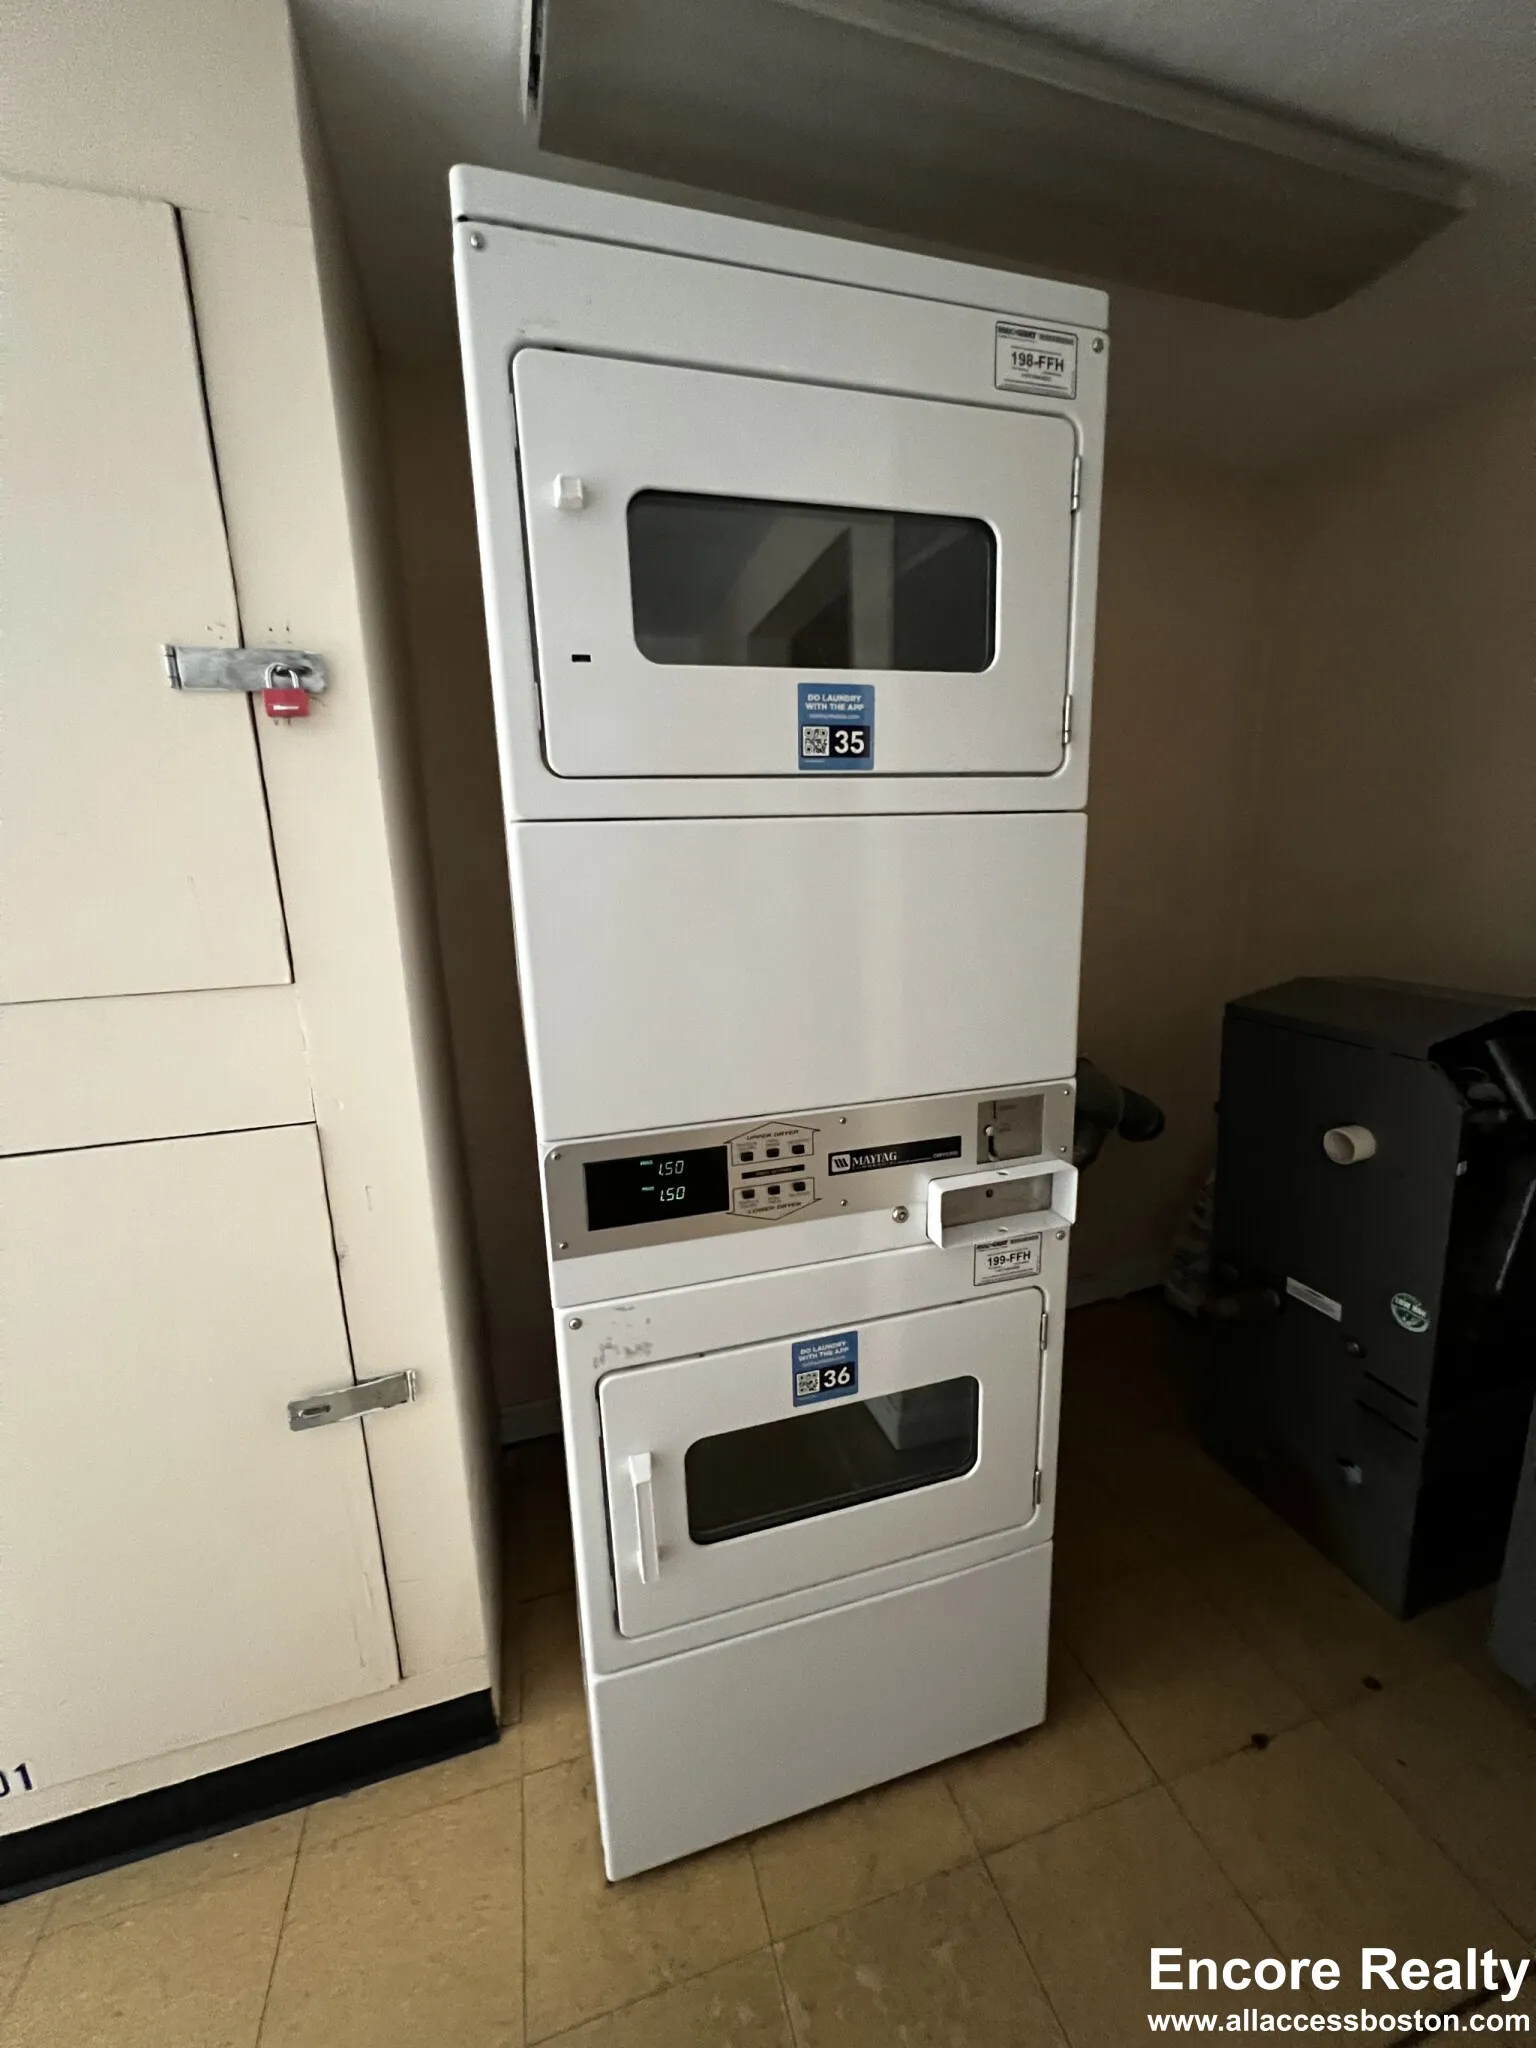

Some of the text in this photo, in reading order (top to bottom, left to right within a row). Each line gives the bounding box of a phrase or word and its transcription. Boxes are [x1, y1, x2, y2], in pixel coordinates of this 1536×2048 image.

[1011, 351, 1064, 372] 198-FFH
[805, 702, 864, 711] WITH THE APP
[807, 694, 861, 703] DO LAUNDRY
[834, 730, 865, 754] 35
[851, 1151, 897, 1166] MAYTAG
[658, 1160, 684, 1176] 1.50
[660, 1186, 686, 1202] 1.50
[987, 1250, 1031, 1266] 199-FFH
[823, 1366, 851, 1388] 36
